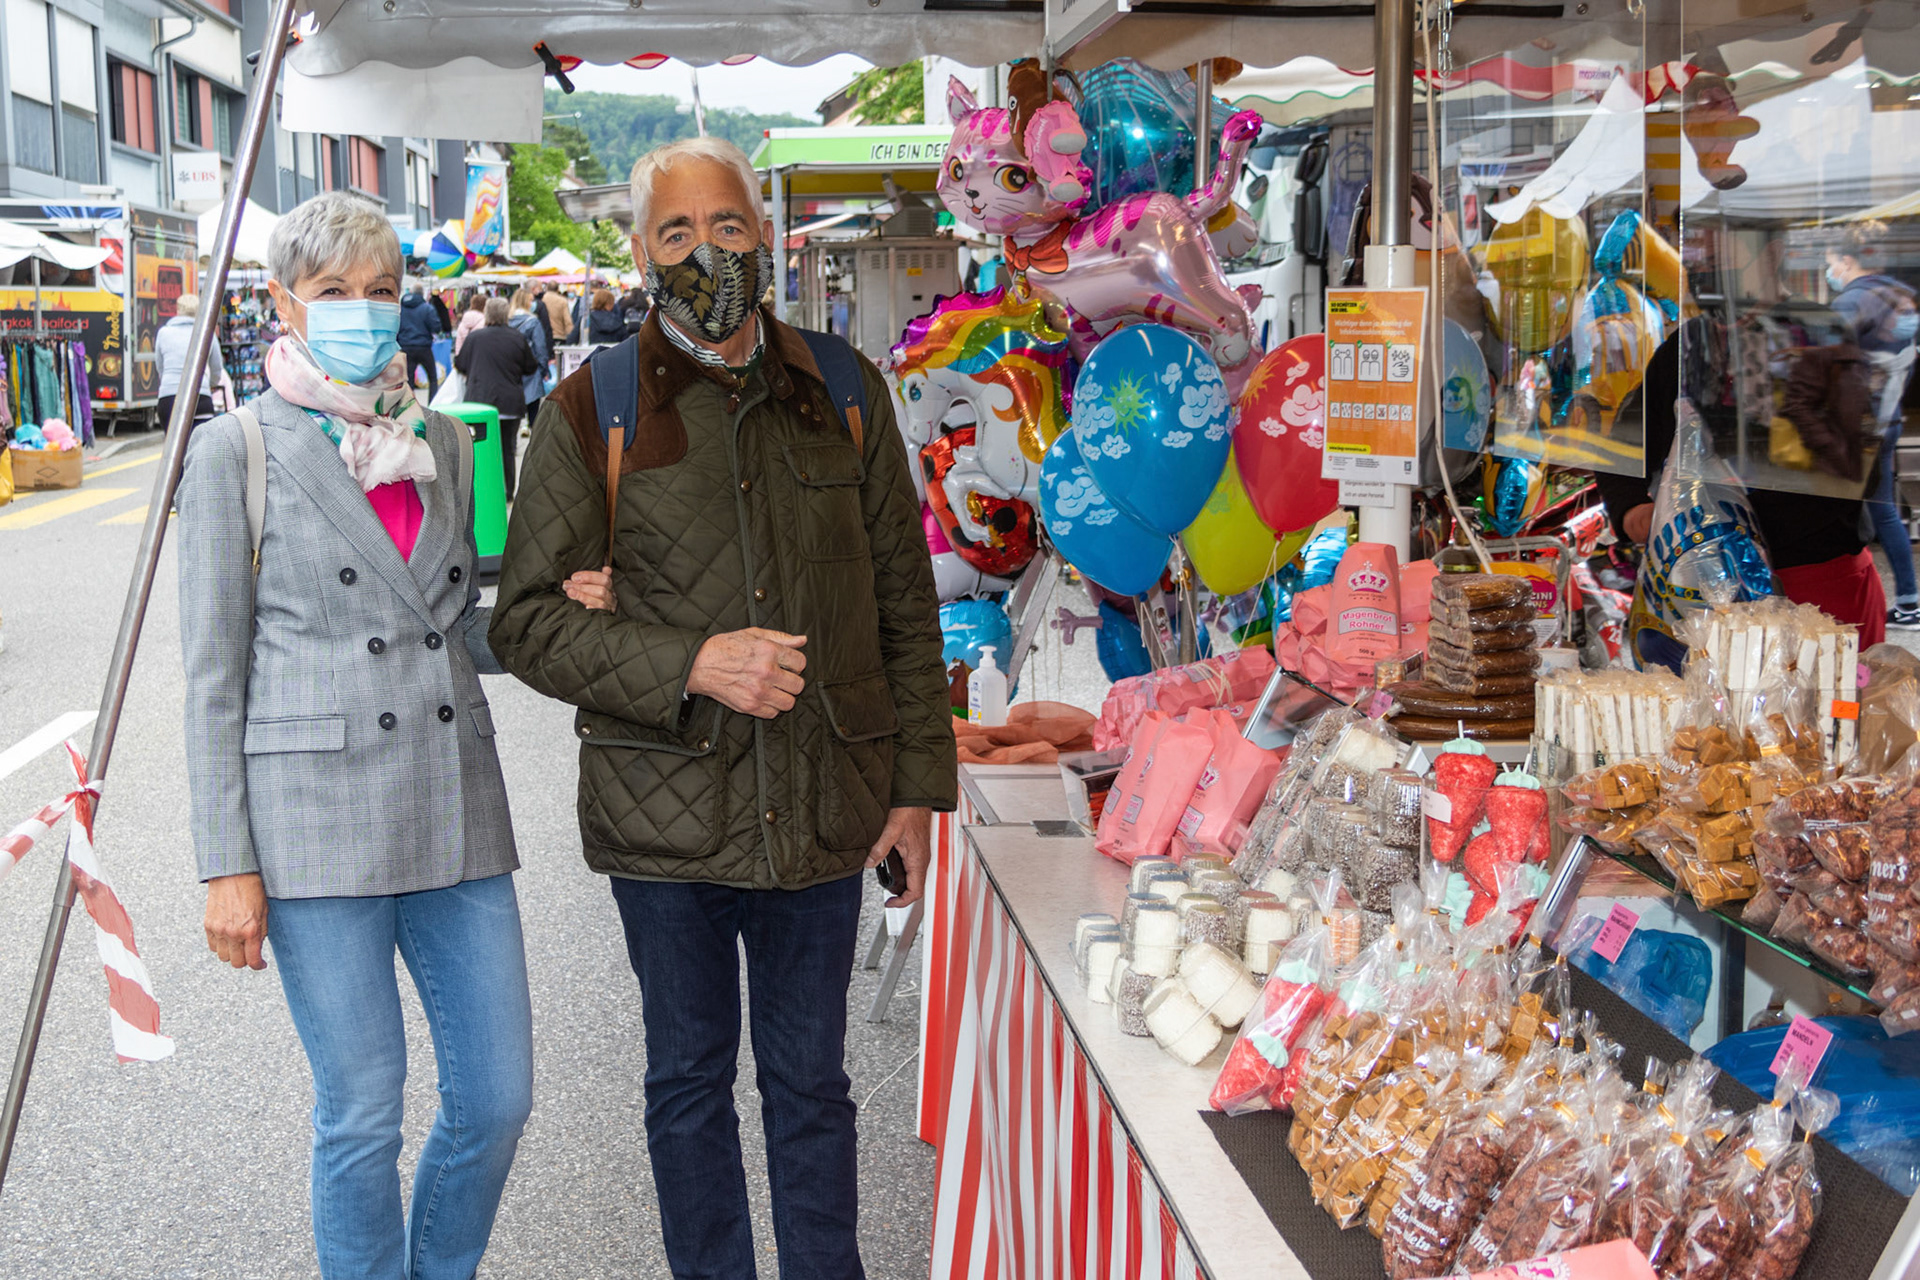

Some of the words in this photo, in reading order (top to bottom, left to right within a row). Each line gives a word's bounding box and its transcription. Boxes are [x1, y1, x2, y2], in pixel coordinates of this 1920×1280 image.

[871, 144, 893, 160] ICH
[897, 144, 921, 159] BIN
[192, 171, 216, 181] UBS
[41, 317, 89, 329] haifood
[1342, 611, 1392, 622] Magenbrot
[1349, 620, 1385, 631] Rohner
[1792, 1028, 1814, 1047] MANDELN
